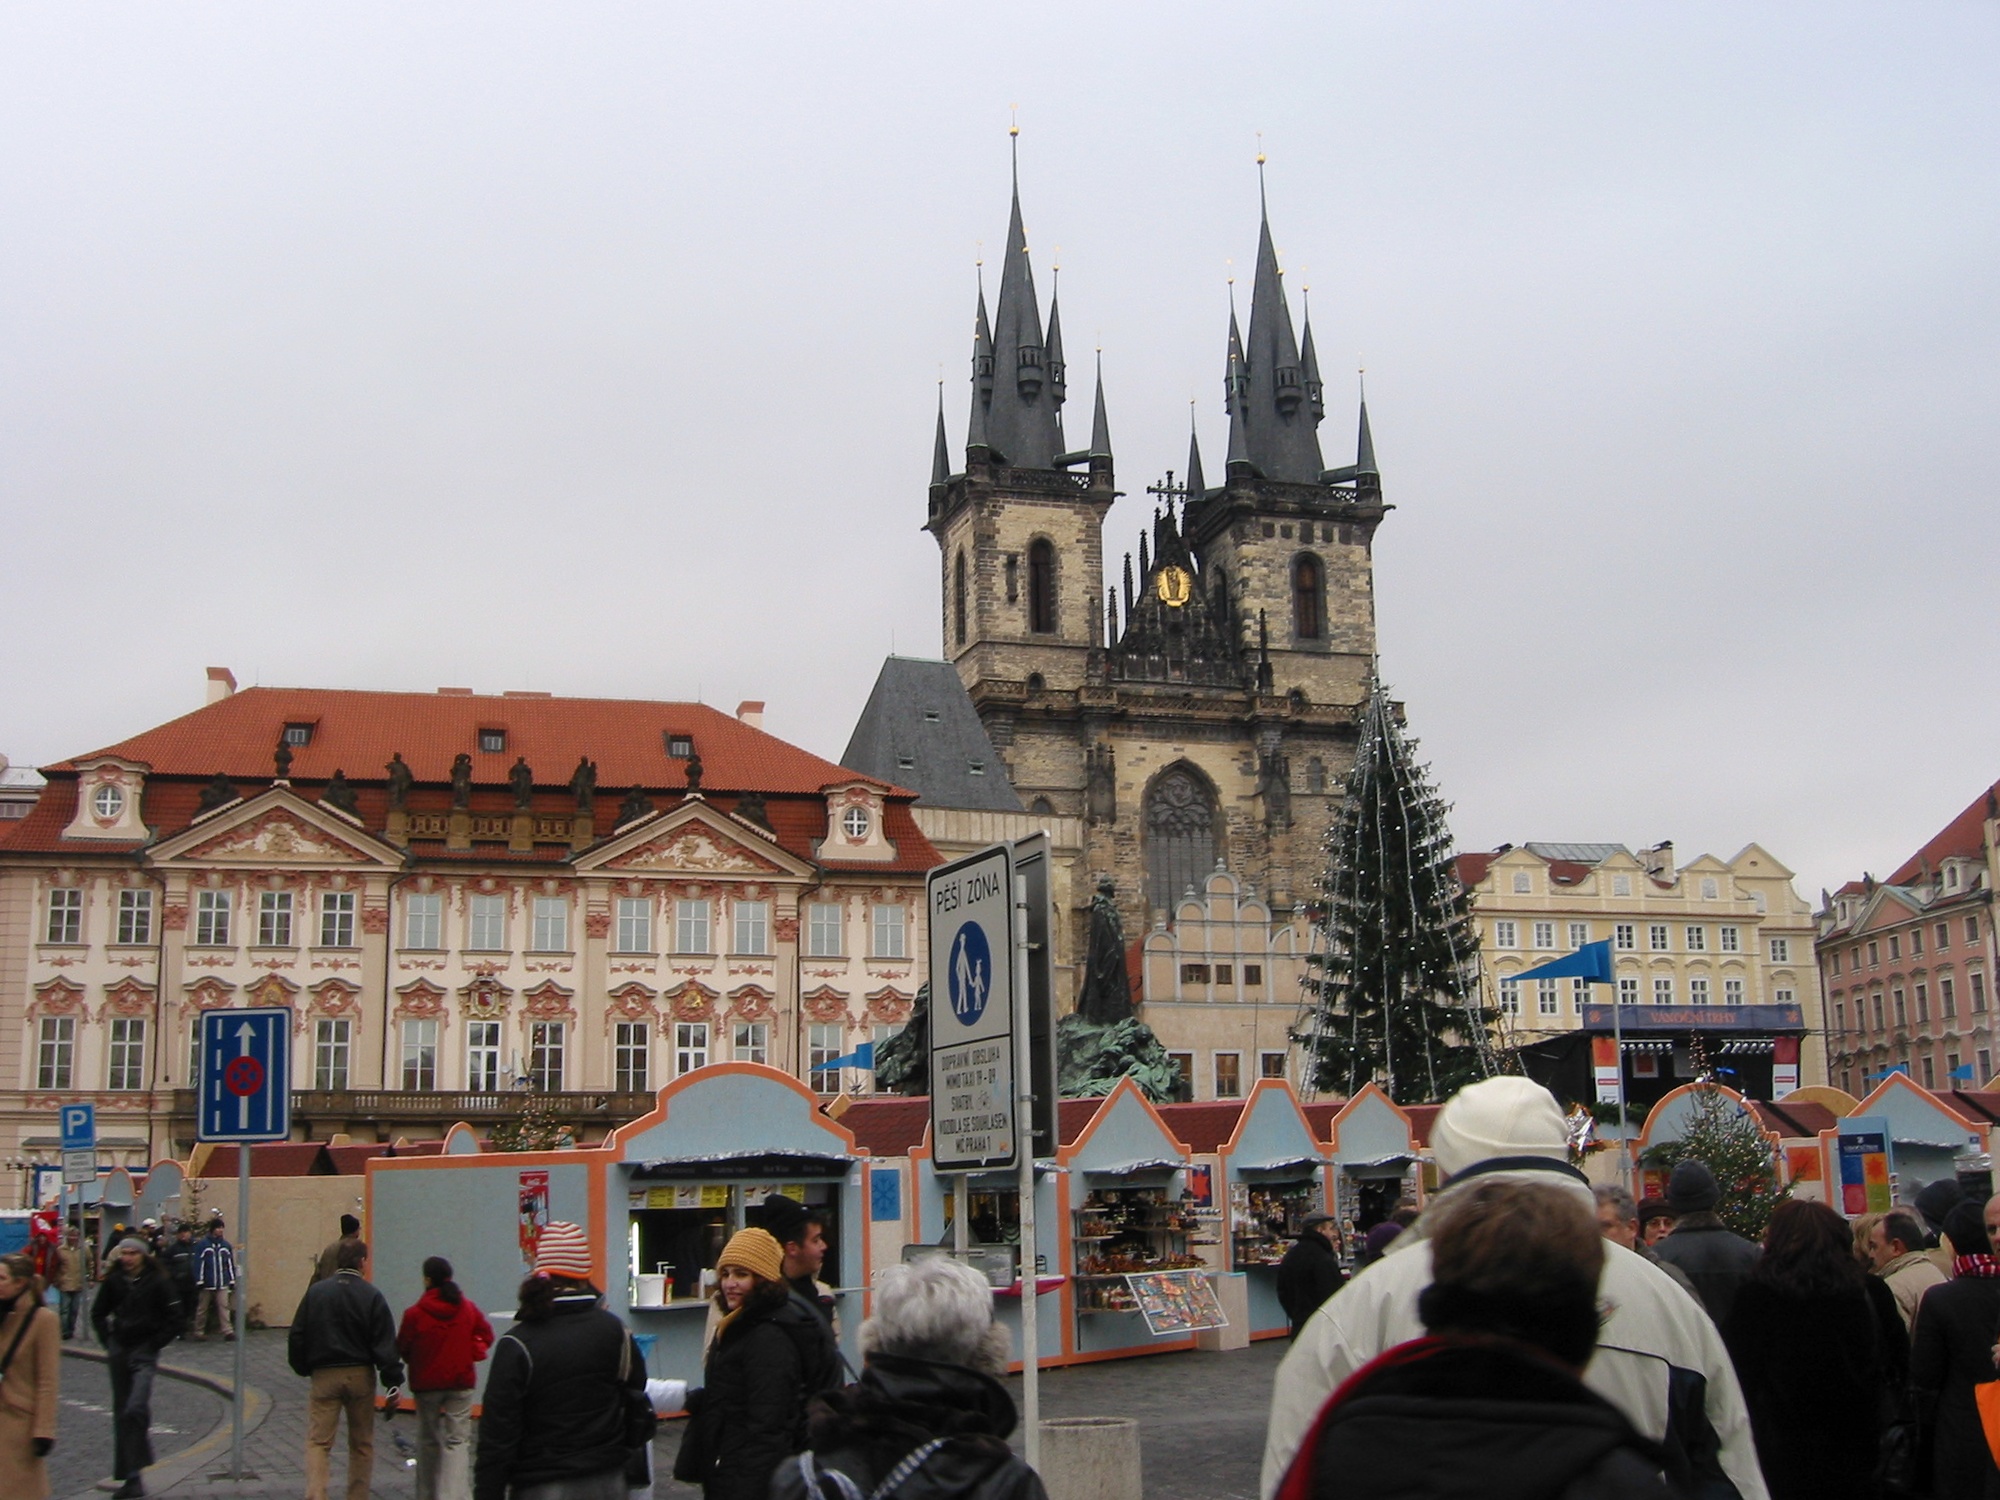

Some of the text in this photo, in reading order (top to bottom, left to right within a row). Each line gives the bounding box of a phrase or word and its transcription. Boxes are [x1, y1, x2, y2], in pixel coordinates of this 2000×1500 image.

[936, 872, 1000, 915] PĚŠÍ ZÓNA
[67, 1109, 87, 1136] P
